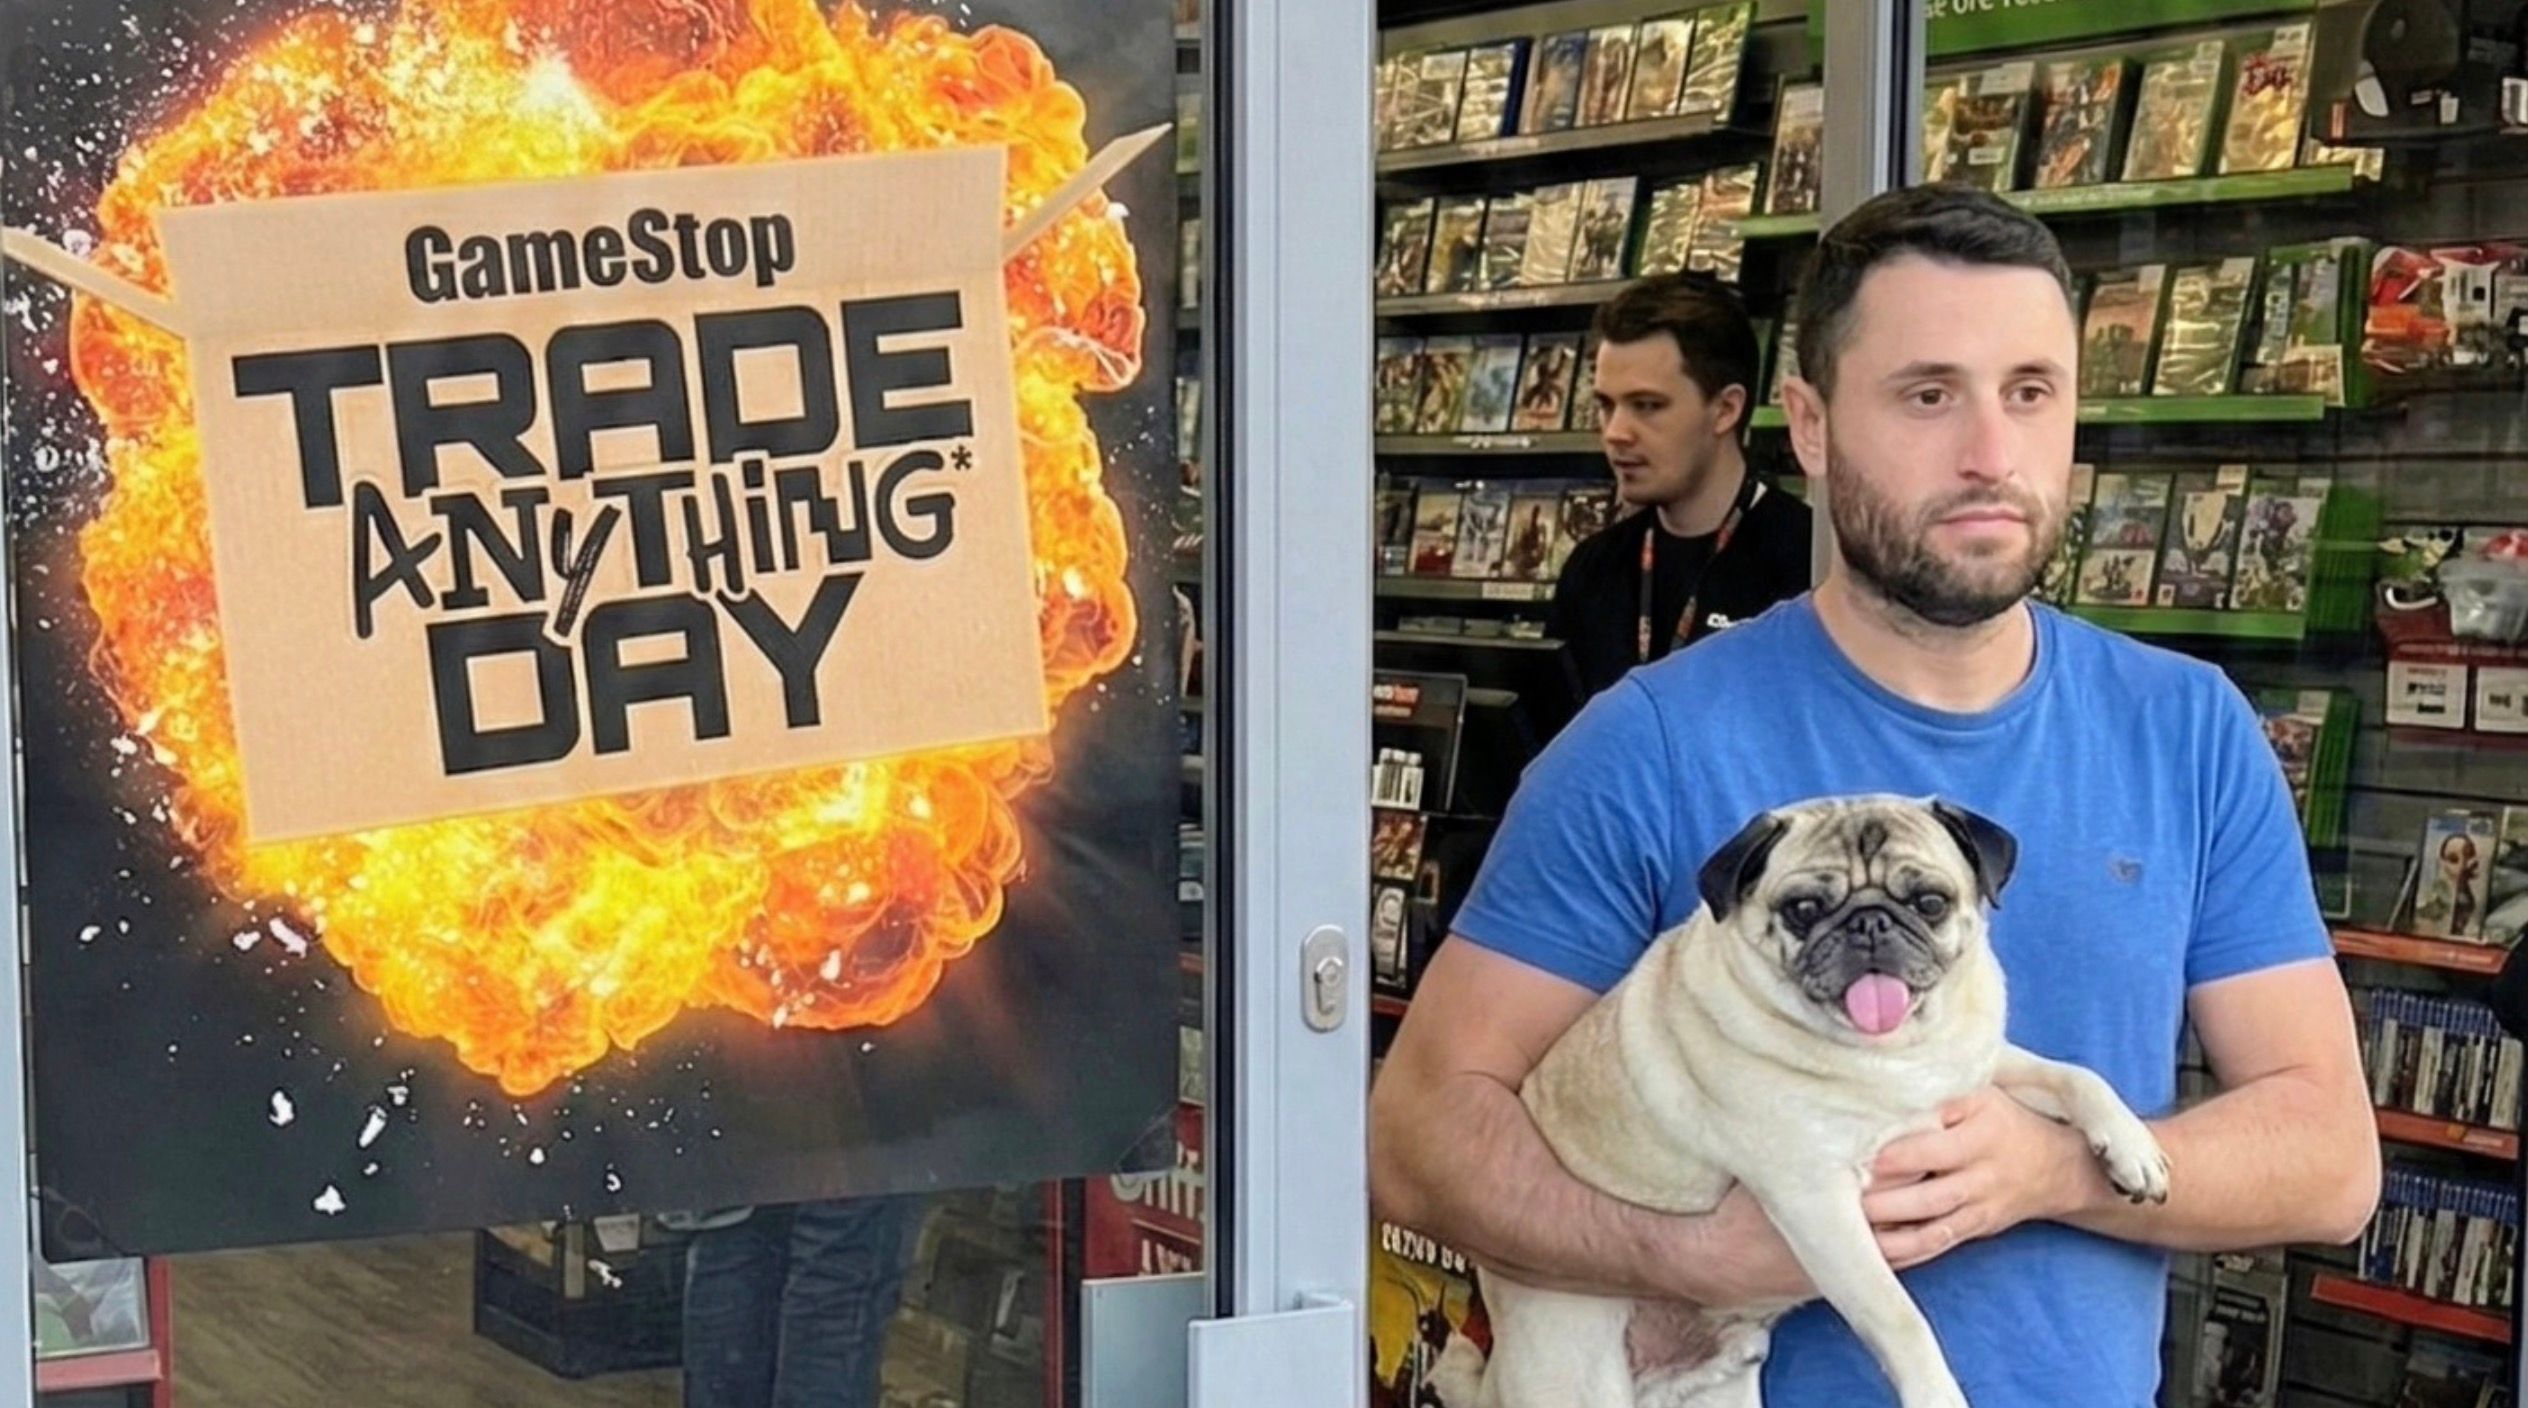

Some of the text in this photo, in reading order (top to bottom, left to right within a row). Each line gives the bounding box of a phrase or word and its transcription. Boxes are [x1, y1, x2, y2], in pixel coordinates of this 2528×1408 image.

[405, 207, 796, 302] GameStop
[232, 290, 974, 509] TRADE
[426, 571, 864, 777] DAY
